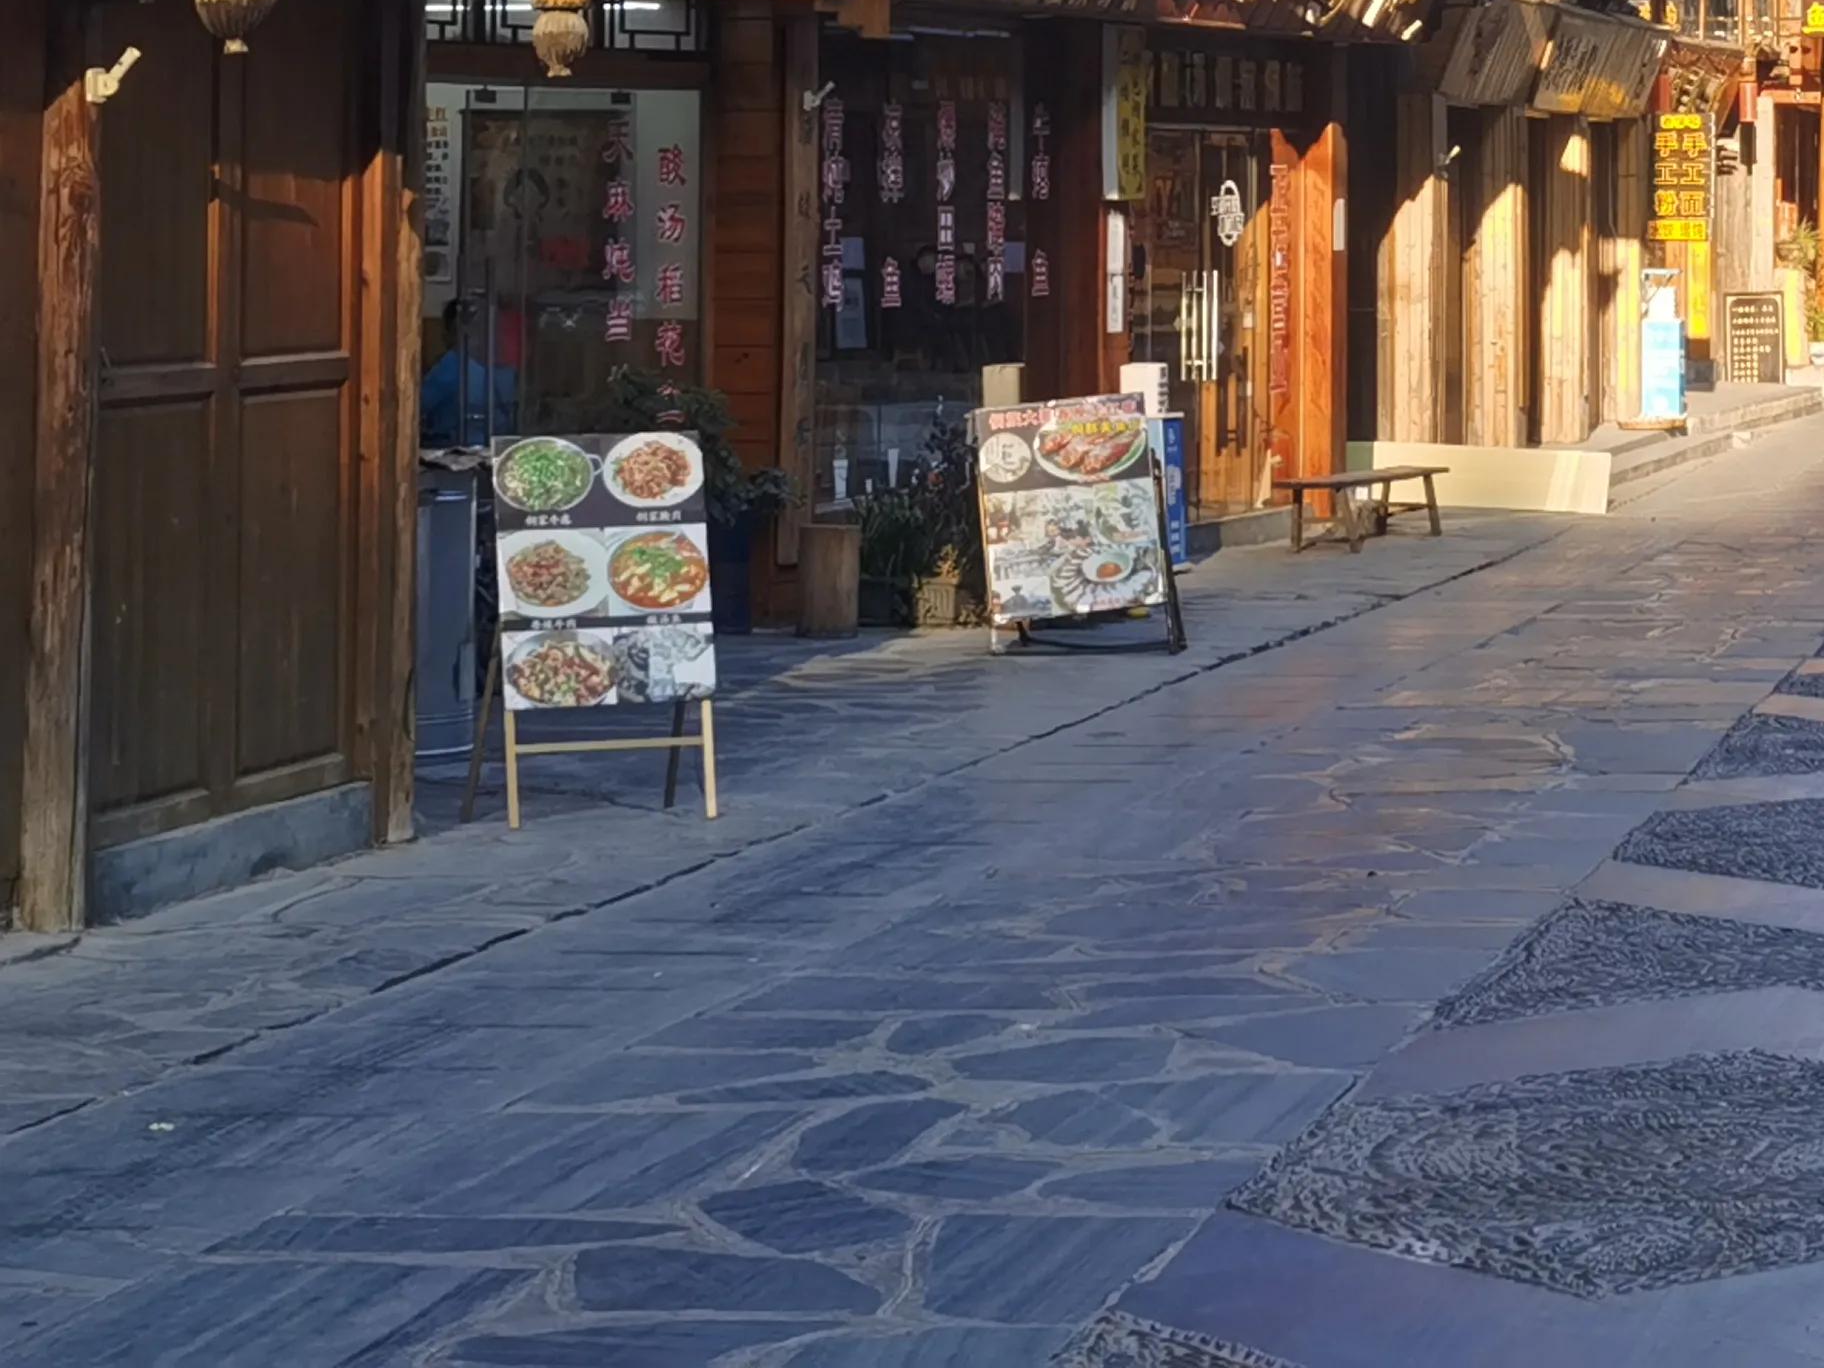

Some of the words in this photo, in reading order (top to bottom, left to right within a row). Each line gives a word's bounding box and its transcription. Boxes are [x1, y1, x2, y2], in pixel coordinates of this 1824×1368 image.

[1654, 131, 1679, 218] 手工粉
[1679, 131, 1708, 218] 手工面
